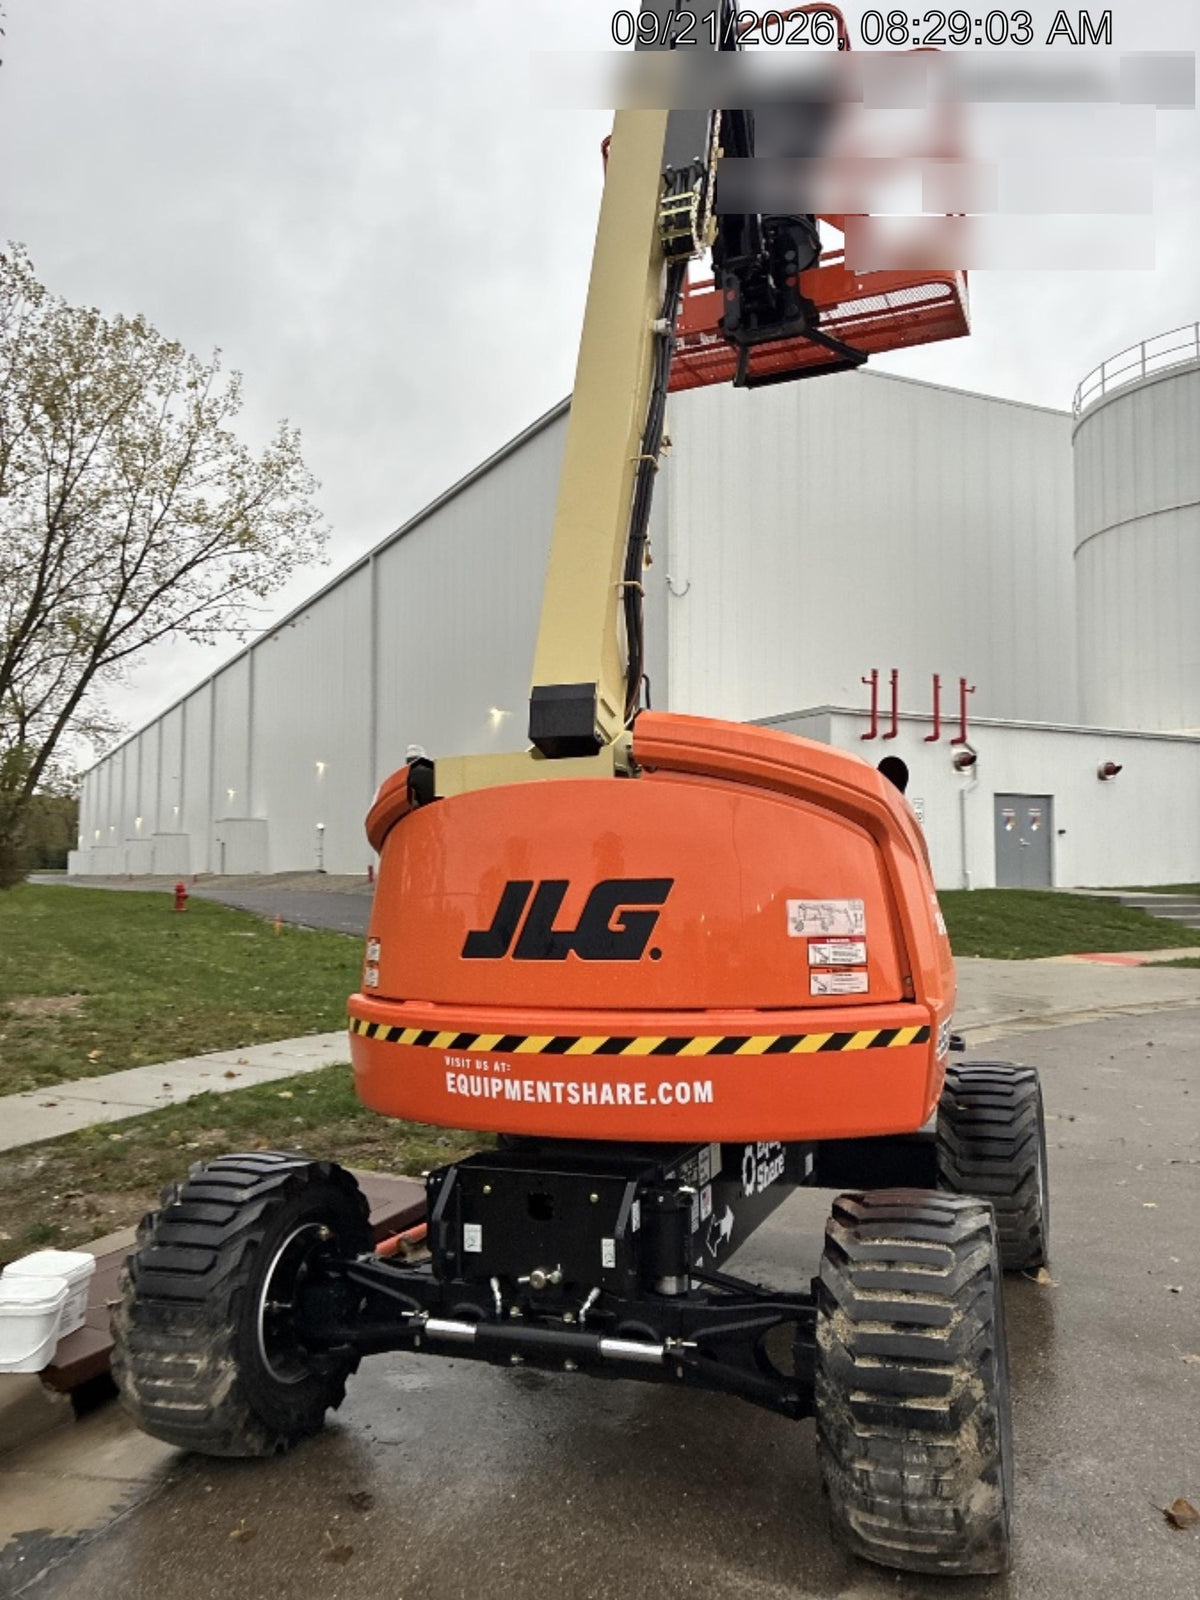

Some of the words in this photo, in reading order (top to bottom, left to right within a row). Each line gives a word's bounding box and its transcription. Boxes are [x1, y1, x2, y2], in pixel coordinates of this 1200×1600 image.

[444, 1055, 472, 1069] VISIT
[475, 1059, 489, 1072] US
[445, 1072, 714, 1105] EQUIPMENTSHARE.COM
